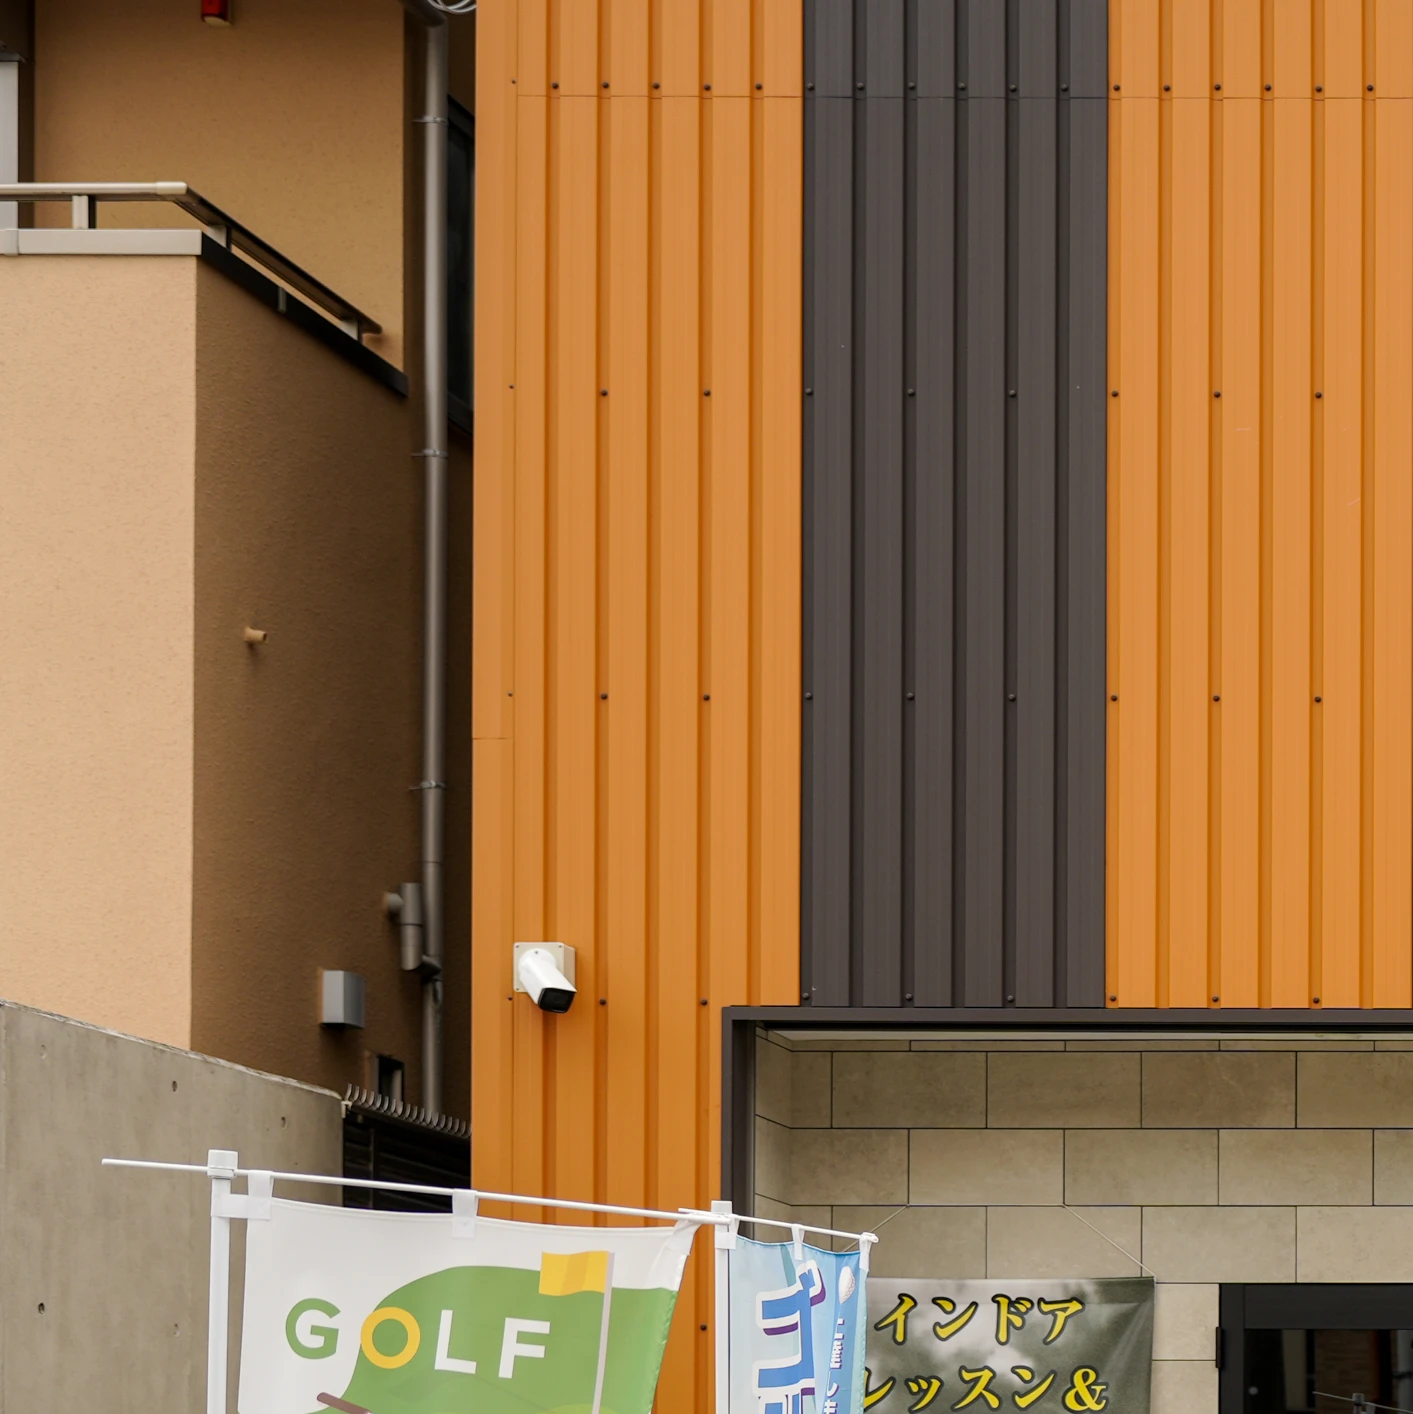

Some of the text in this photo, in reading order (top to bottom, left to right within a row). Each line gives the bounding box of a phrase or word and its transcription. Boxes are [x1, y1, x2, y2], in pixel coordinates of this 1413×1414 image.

[285, 1297, 551, 1379] GOLF
[874, 1292, 1085, 1345] インドア
